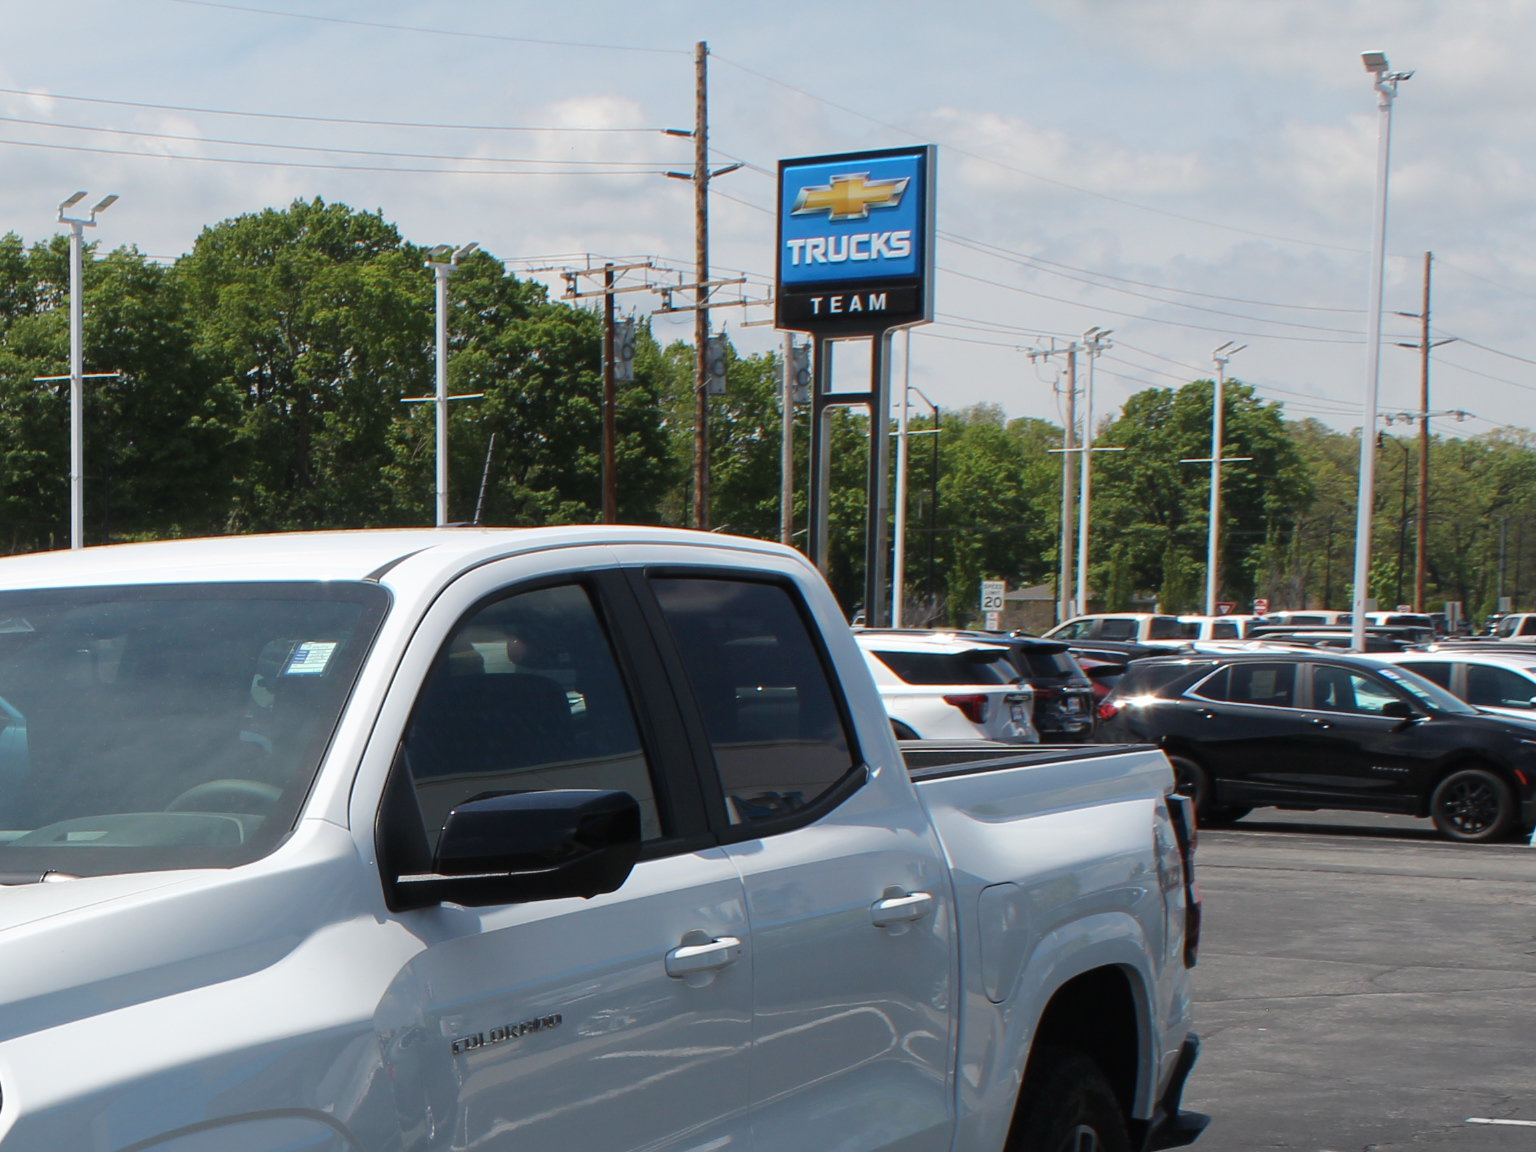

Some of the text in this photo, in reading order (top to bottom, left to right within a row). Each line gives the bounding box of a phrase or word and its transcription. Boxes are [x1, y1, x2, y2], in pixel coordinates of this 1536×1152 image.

[787, 230, 912, 265] TRUCKS
[810, 292, 887, 315] TEAM
[984, 596, 1002, 608] 20
